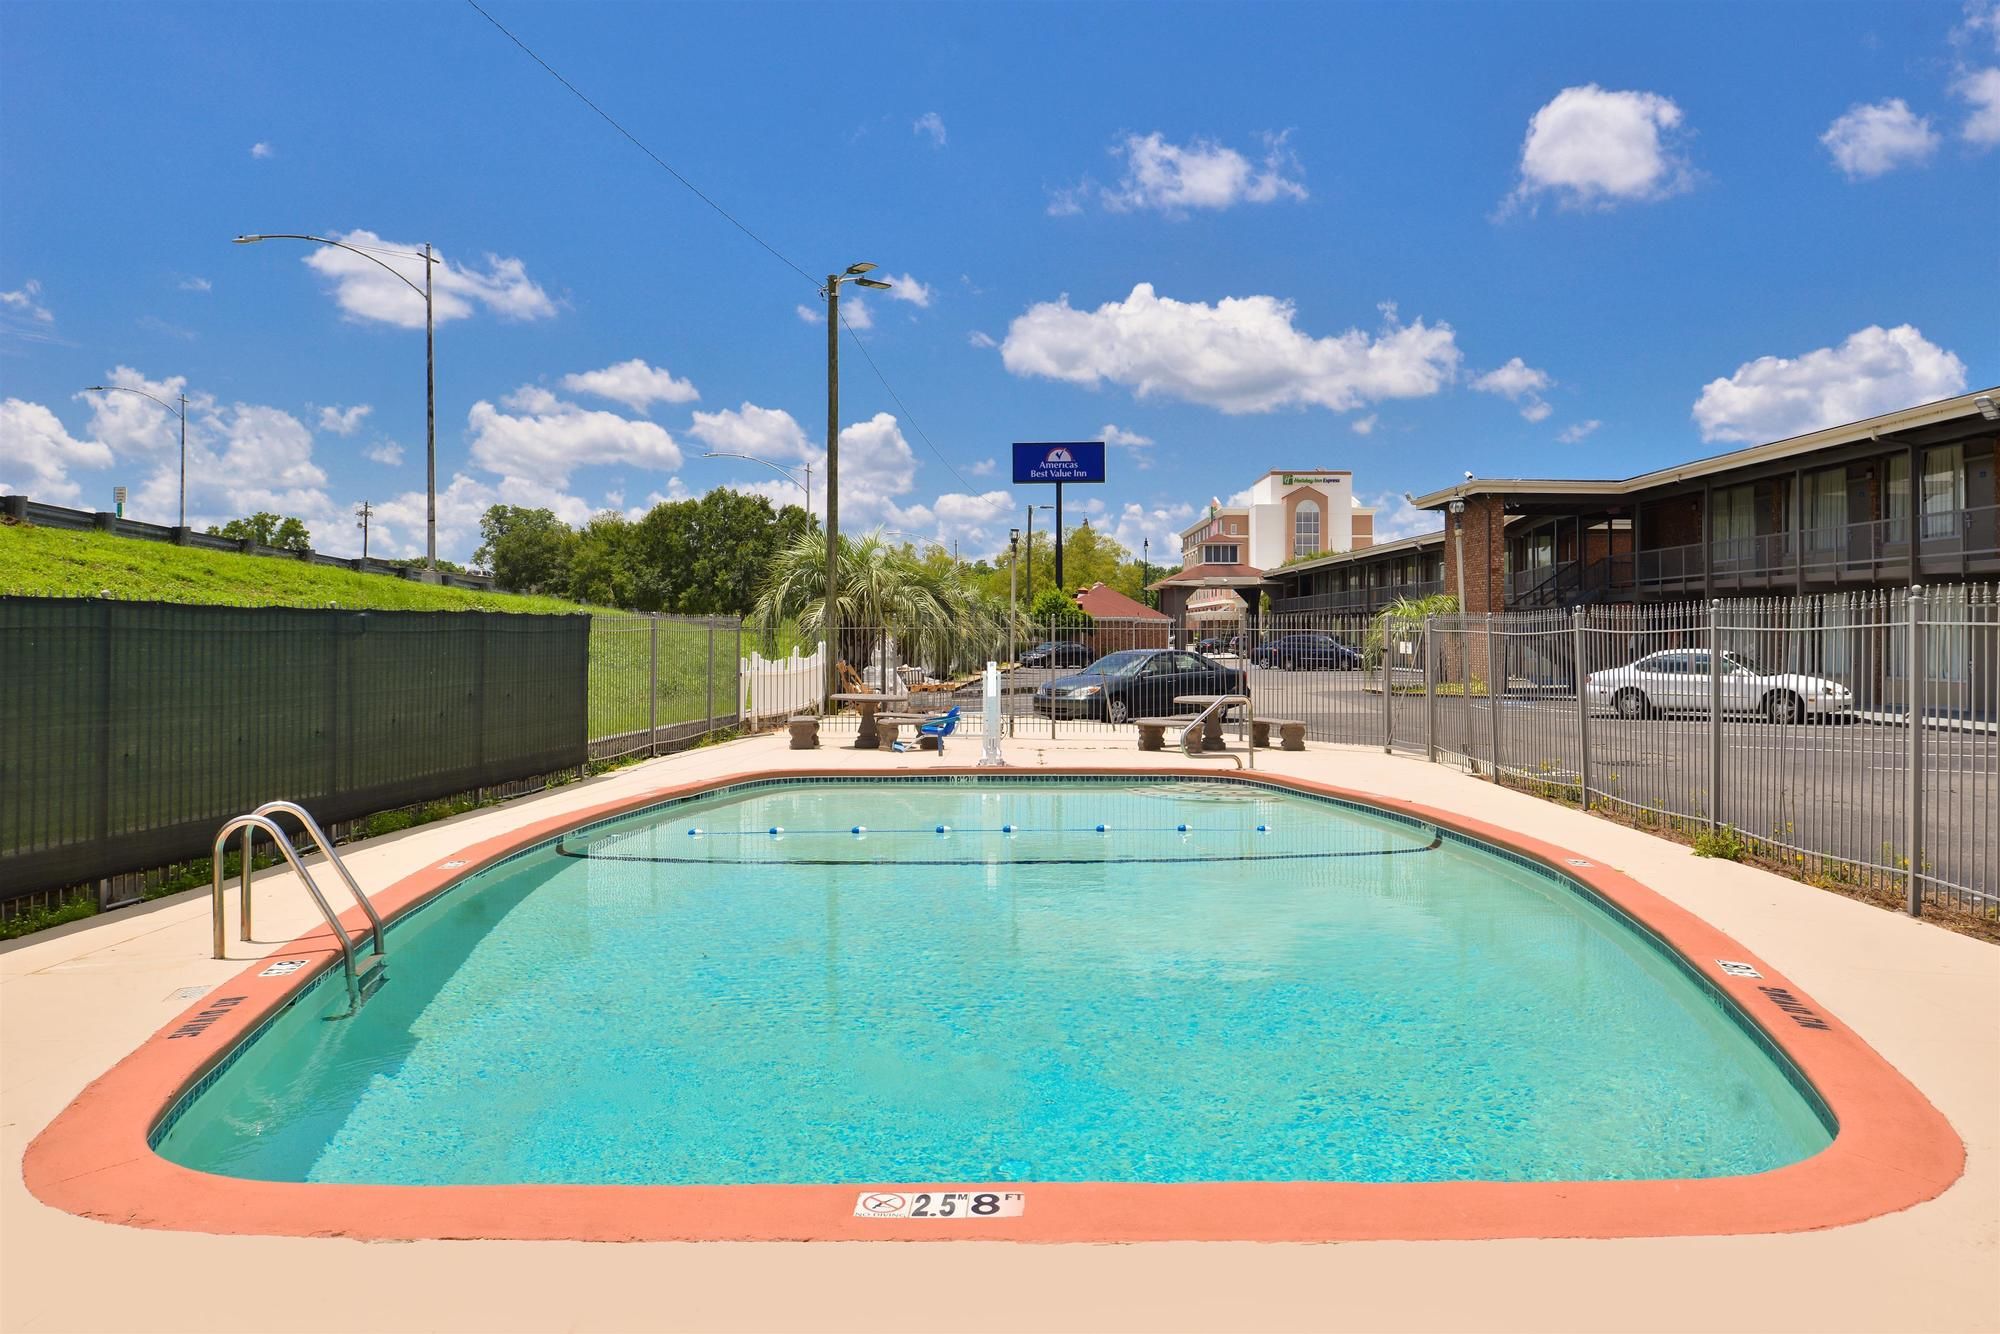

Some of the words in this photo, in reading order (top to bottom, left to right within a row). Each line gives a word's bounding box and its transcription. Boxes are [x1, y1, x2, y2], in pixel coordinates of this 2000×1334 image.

[1040, 461, 1079, 469] Americas
[1030, 469, 1048, 478] Best
[1049, 469, 1072, 478] Value
[1073, 469, 1088, 477] Inn
